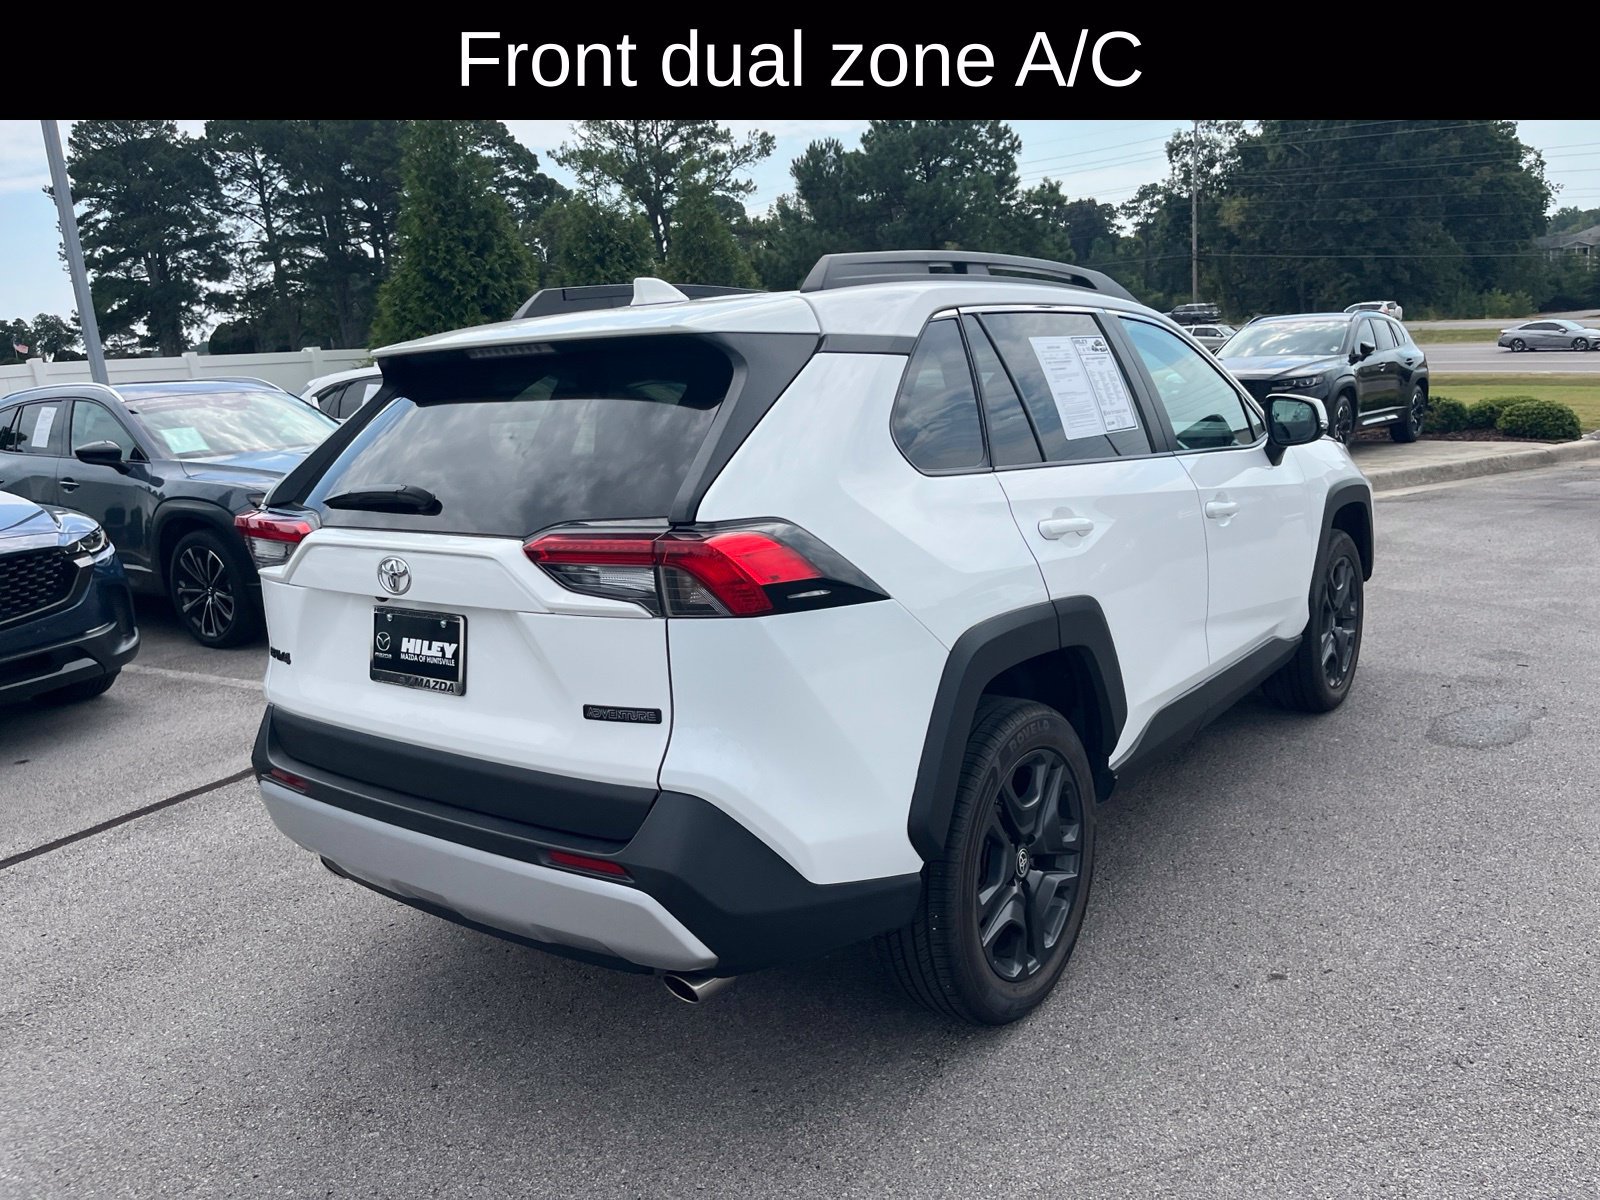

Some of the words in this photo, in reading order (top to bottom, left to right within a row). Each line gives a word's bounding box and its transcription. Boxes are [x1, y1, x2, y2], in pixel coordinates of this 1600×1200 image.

[401, 637, 458, 659] HILEY
[400, 652, 419, 662] MAZDA
[419, 655, 426, 663] OF
[426, 656, 456, 667] HUNTSVILLE
[415, 677, 455, 693] MAZDA
[587, 707, 657, 721] ADVENTURE
